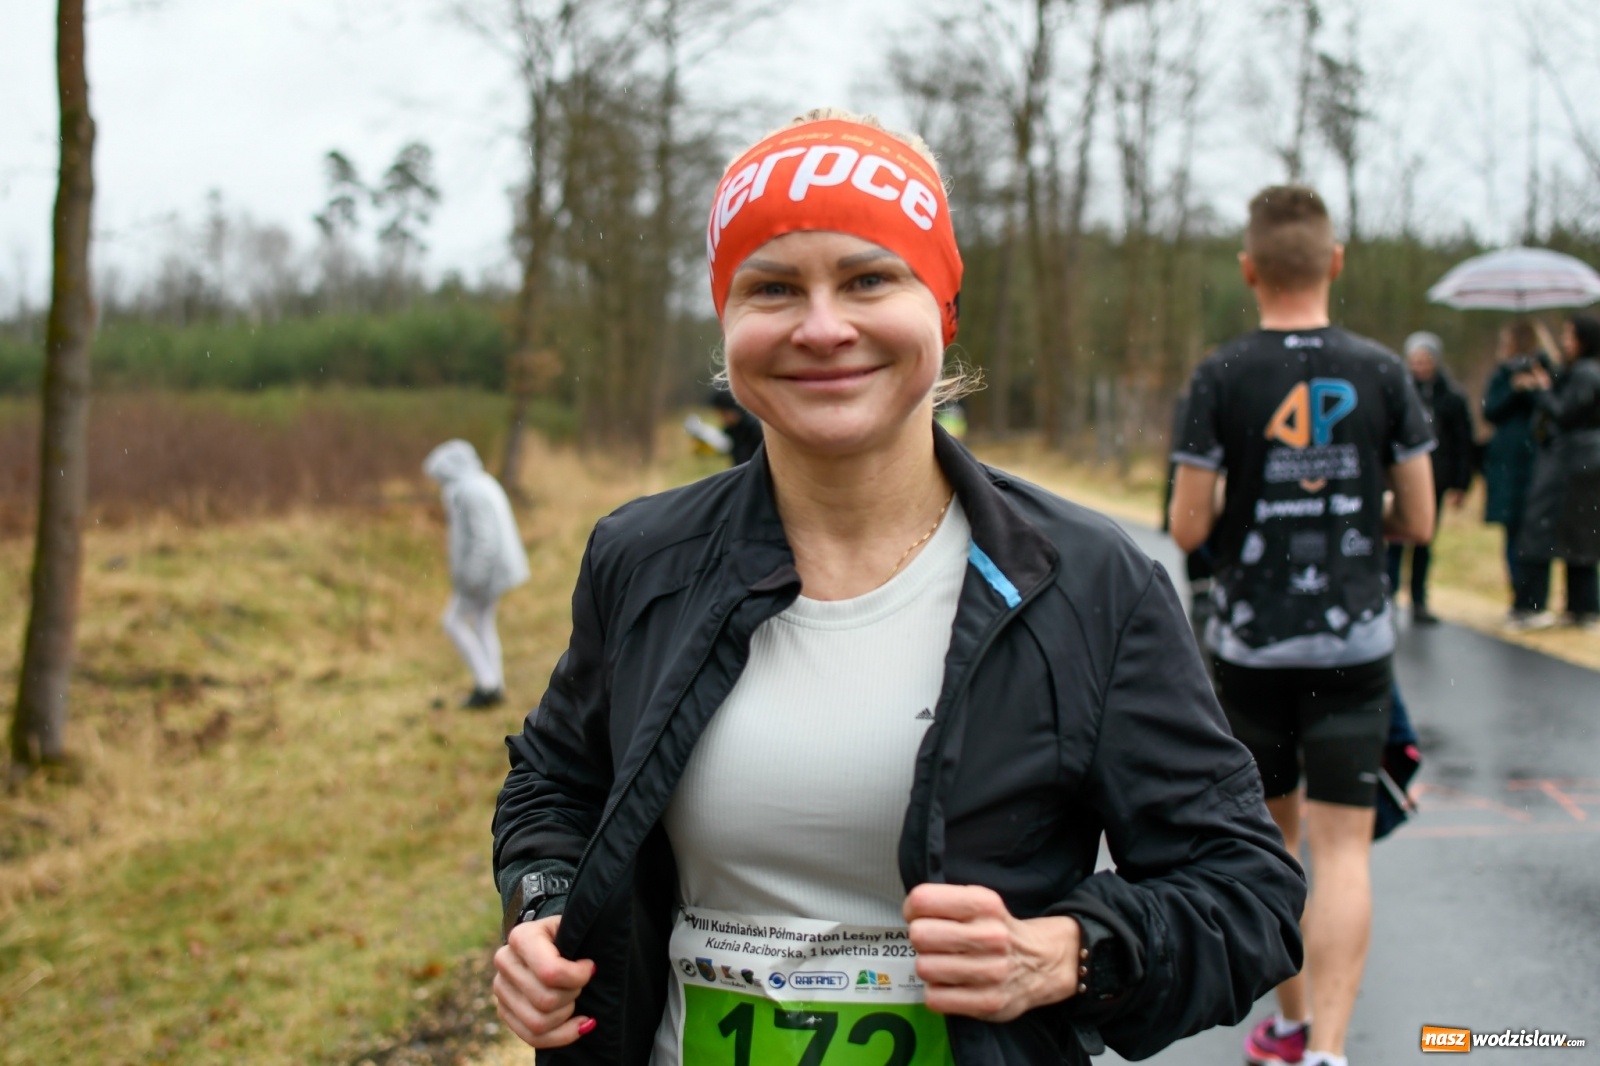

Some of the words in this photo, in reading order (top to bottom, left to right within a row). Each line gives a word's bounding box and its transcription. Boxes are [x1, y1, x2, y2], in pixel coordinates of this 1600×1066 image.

[711, 919, 767, 938] Kuźniański
[769, 926, 839, 943] Półmaraton
[843, 930, 881, 942] Leśny
[705, 936, 741, 952] Kuźnia
[742, 941, 807, 959] Raciborska,
[810, 947, 817, 957] 1
[821, 944, 879, 957] kwietnia
[882, 944, 917, 957] 2023
[794, 975, 844, 986] RAFAMET
